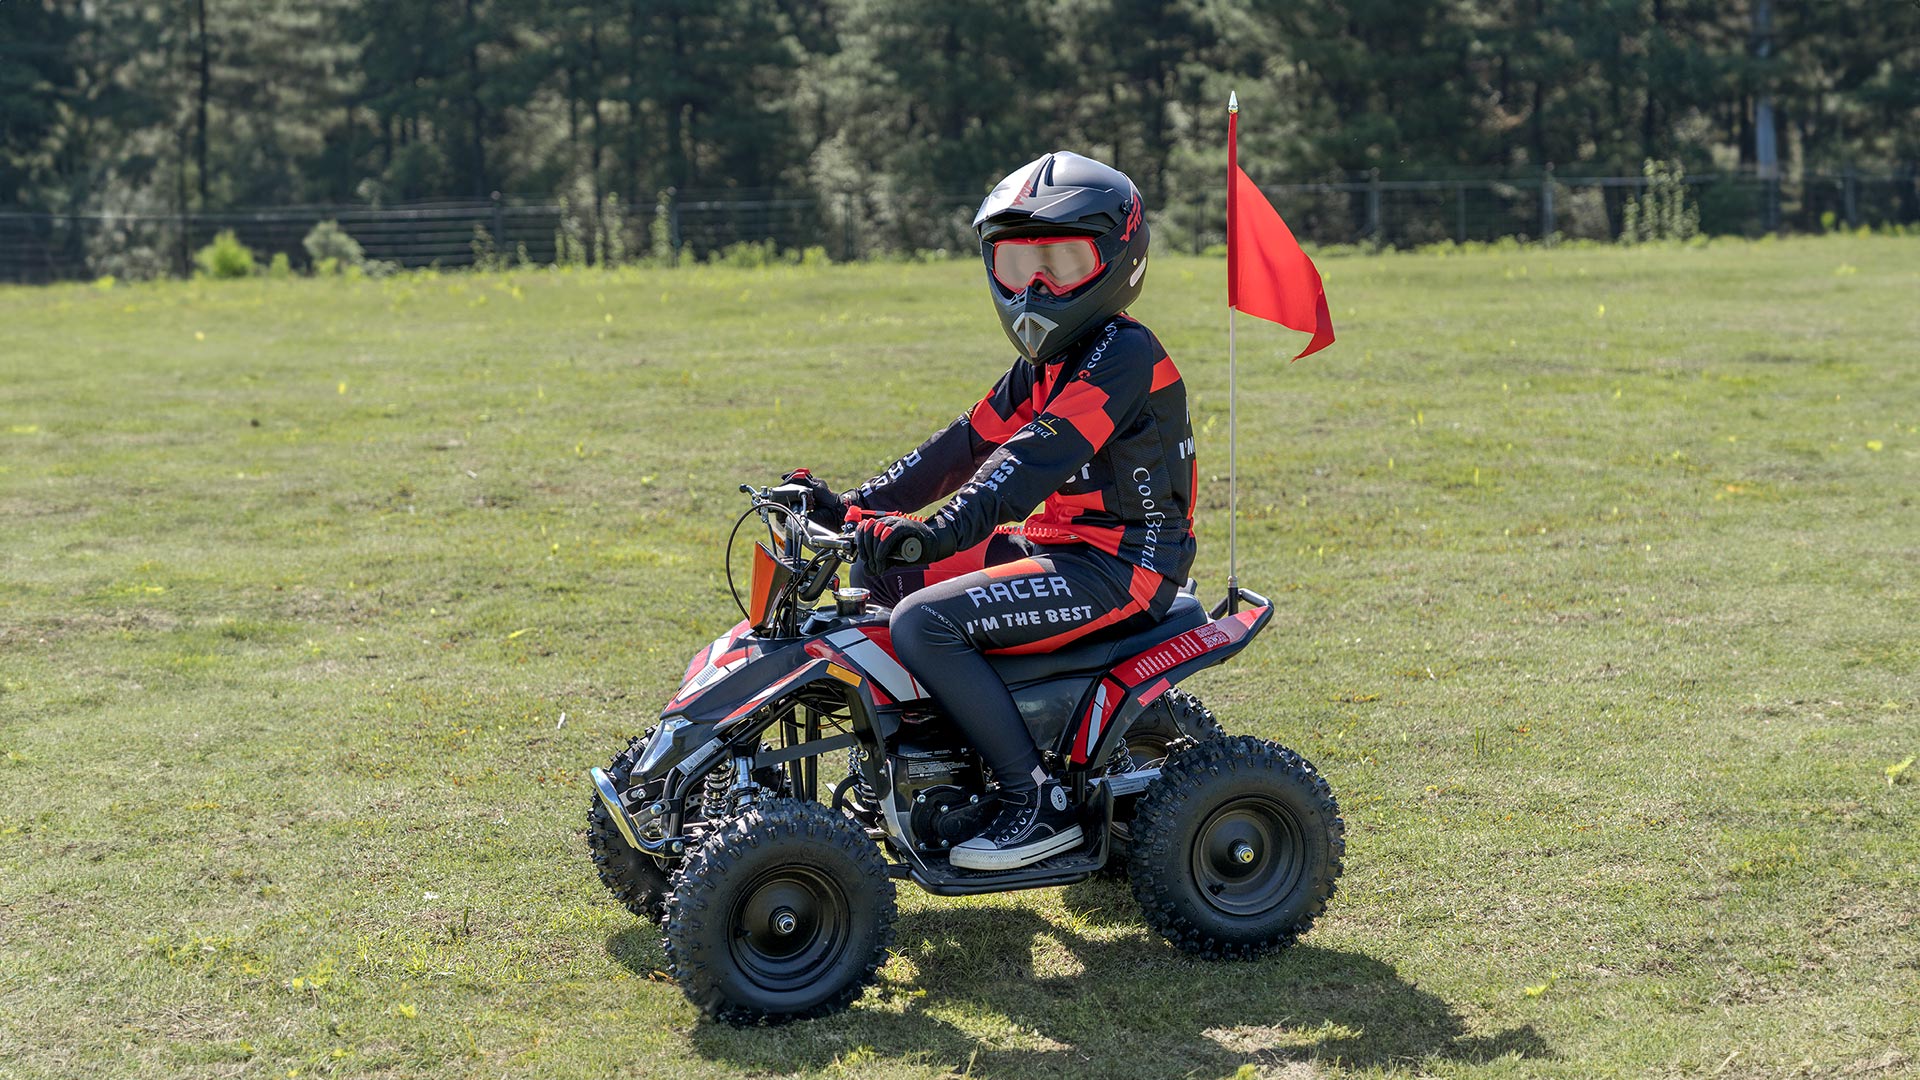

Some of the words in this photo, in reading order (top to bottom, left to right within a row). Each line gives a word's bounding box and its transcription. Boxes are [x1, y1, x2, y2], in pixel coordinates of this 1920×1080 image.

[965, 576, 1073, 608] RACER
[966, 616, 1000, 635] I'M
[1002, 610, 1042, 627] THE
[1045, 605, 1093, 623] BEST
